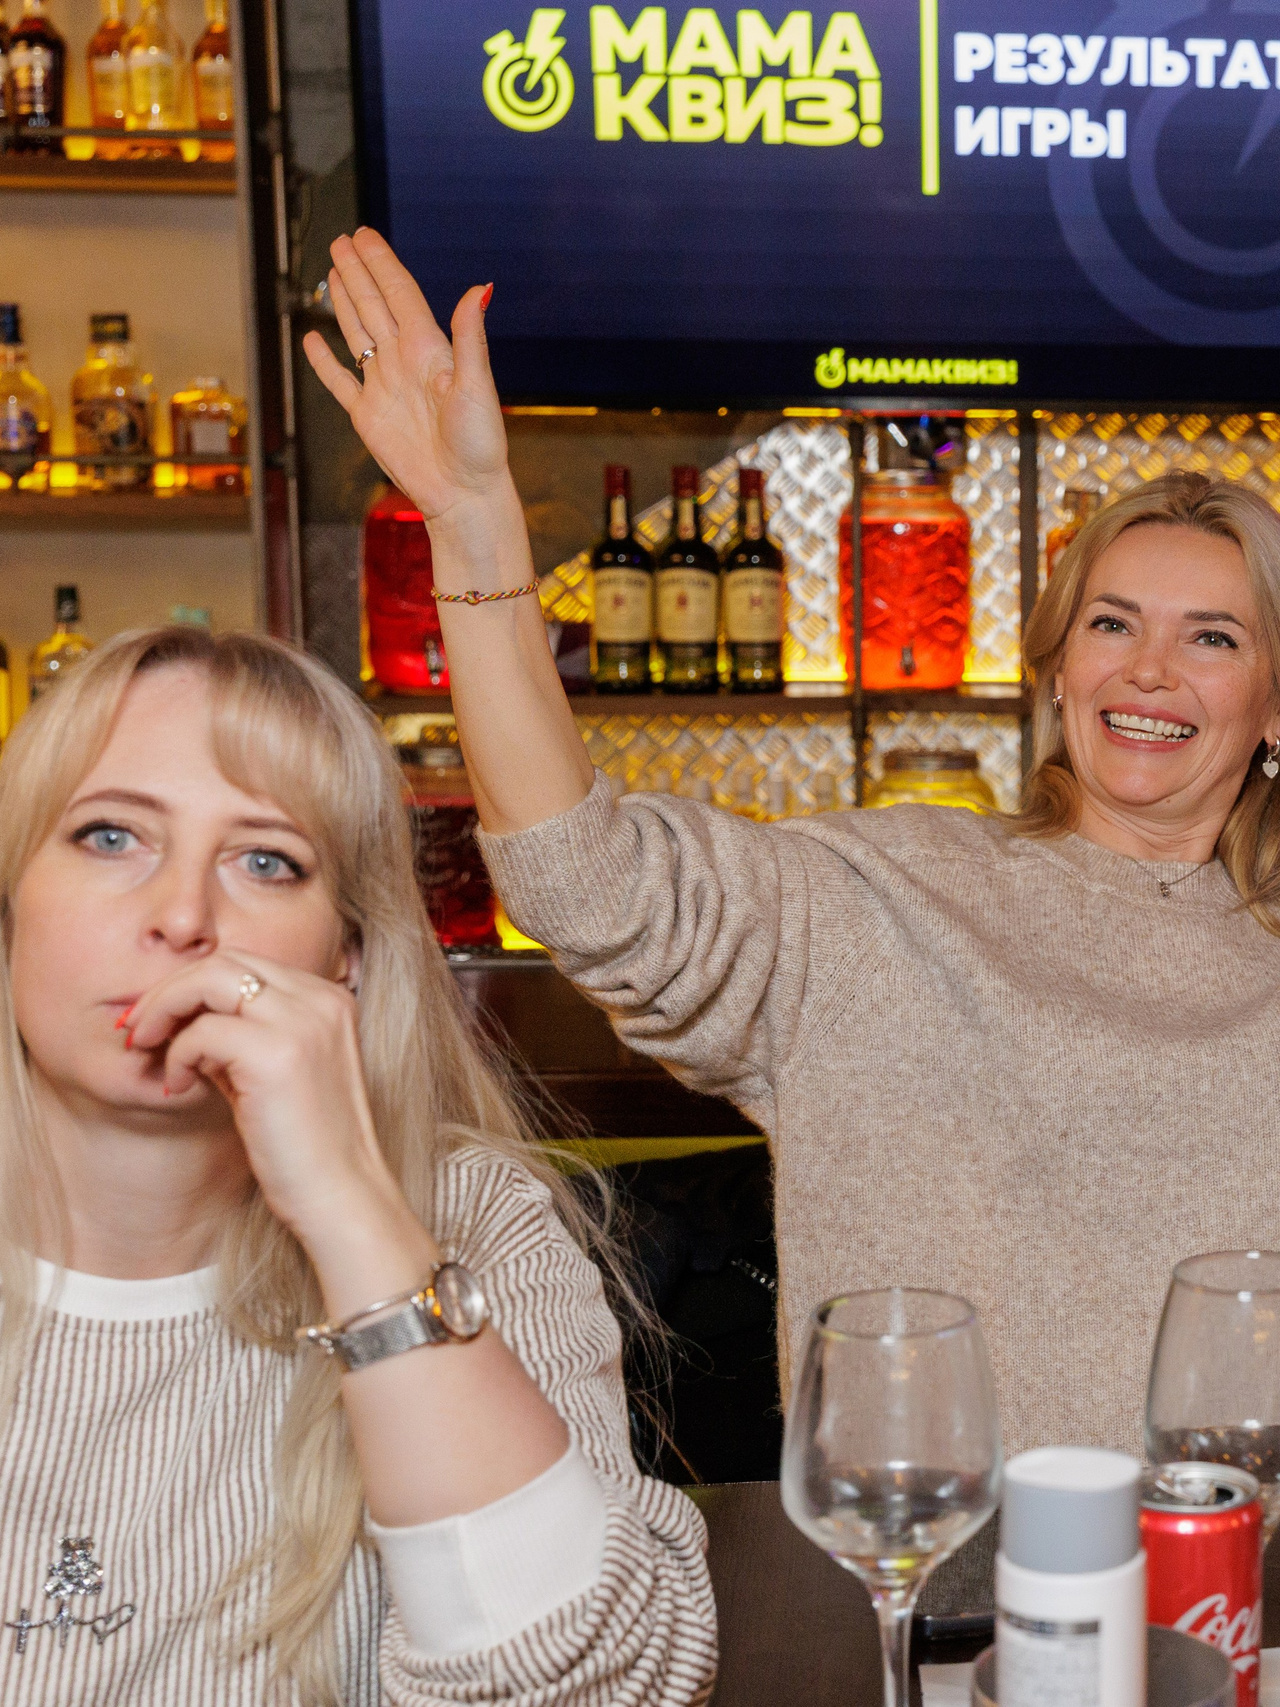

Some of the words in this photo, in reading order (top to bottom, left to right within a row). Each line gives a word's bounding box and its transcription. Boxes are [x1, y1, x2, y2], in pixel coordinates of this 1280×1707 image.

[589, 5, 881, 79] МАМА
[593, 73, 884, 148] КВИЗ!
[954, 106, 1127, 159] ИГРЫ
